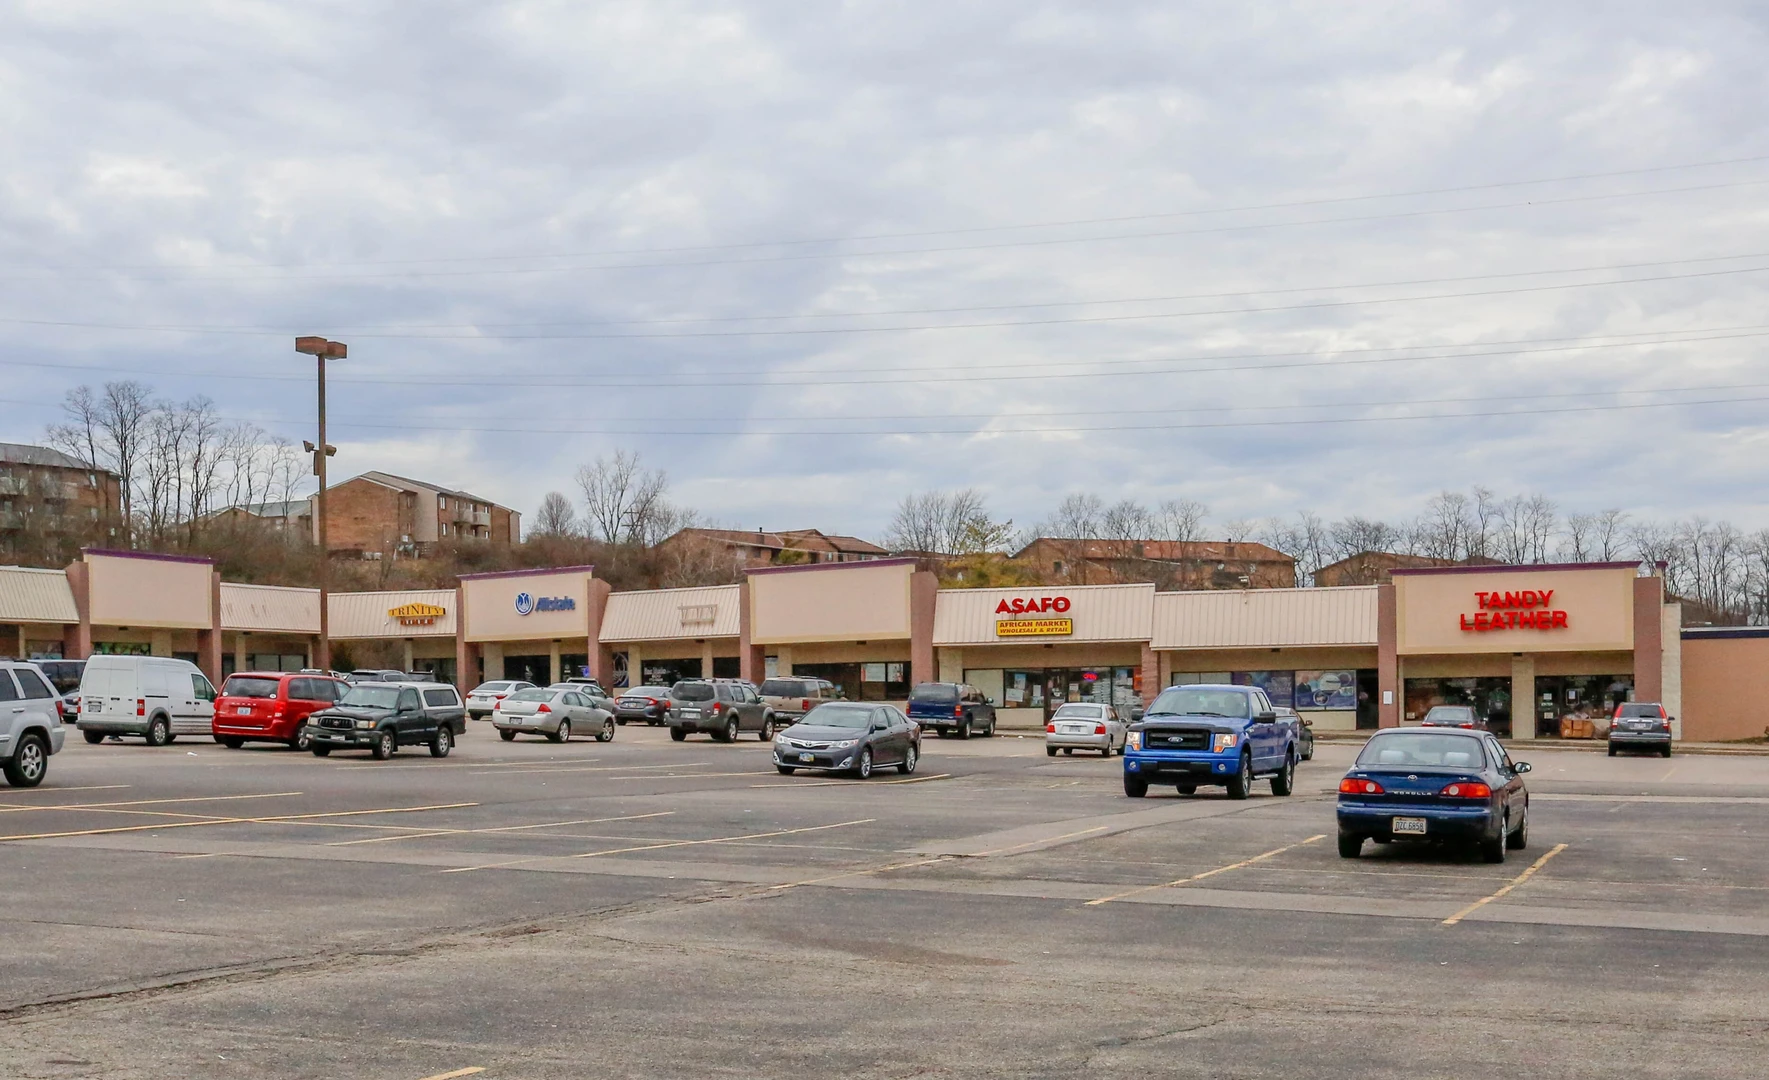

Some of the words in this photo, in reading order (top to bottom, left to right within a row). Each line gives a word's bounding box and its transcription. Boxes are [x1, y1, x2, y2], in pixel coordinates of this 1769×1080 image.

[995, 597, 1071, 614] ASAFO
[1474, 590, 1554, 609] TANDY
[388, 604, 441, 616] TRINITY
[1460, 611, 1568, 630] LEATHER
